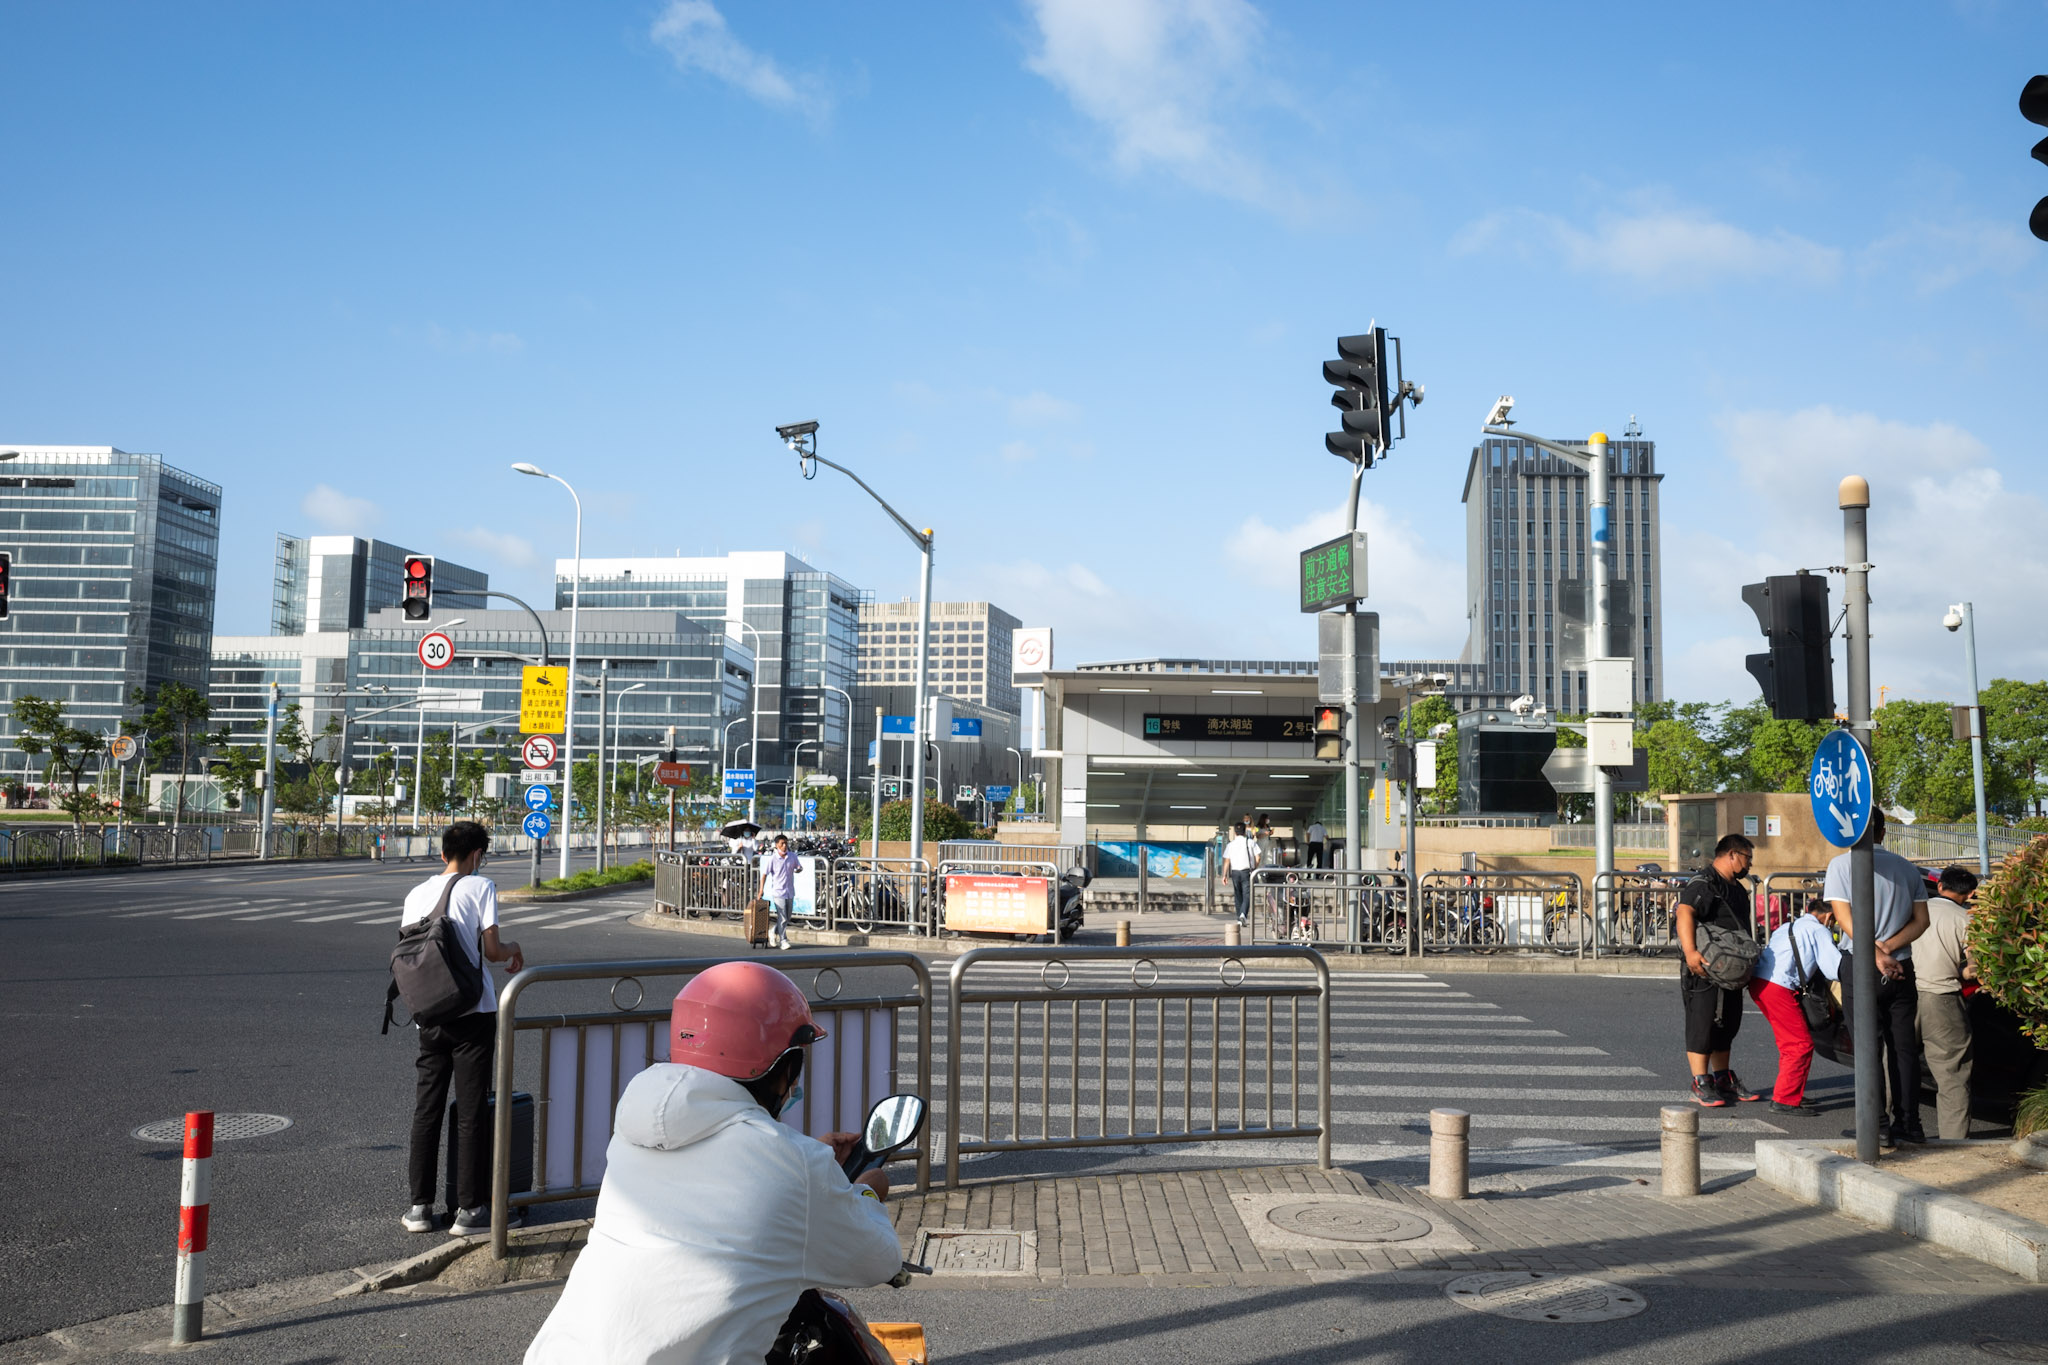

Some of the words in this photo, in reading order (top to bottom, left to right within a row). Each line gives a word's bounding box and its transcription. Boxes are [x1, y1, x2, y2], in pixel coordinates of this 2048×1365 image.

[1304, 544, 1349, 581] 前方通畅
[1305, 569, 1350, 604] 注意安全
[427, 643, 446, 659] 30
[1148, 720, 1159, 731] 16
[1161, 719, 1181, 730] 号线
[1207, 717, 1253, 730] 滴水湖站
[1282, 721, 1294, 737] 2
[525, 772, 552, 782] 出租车
